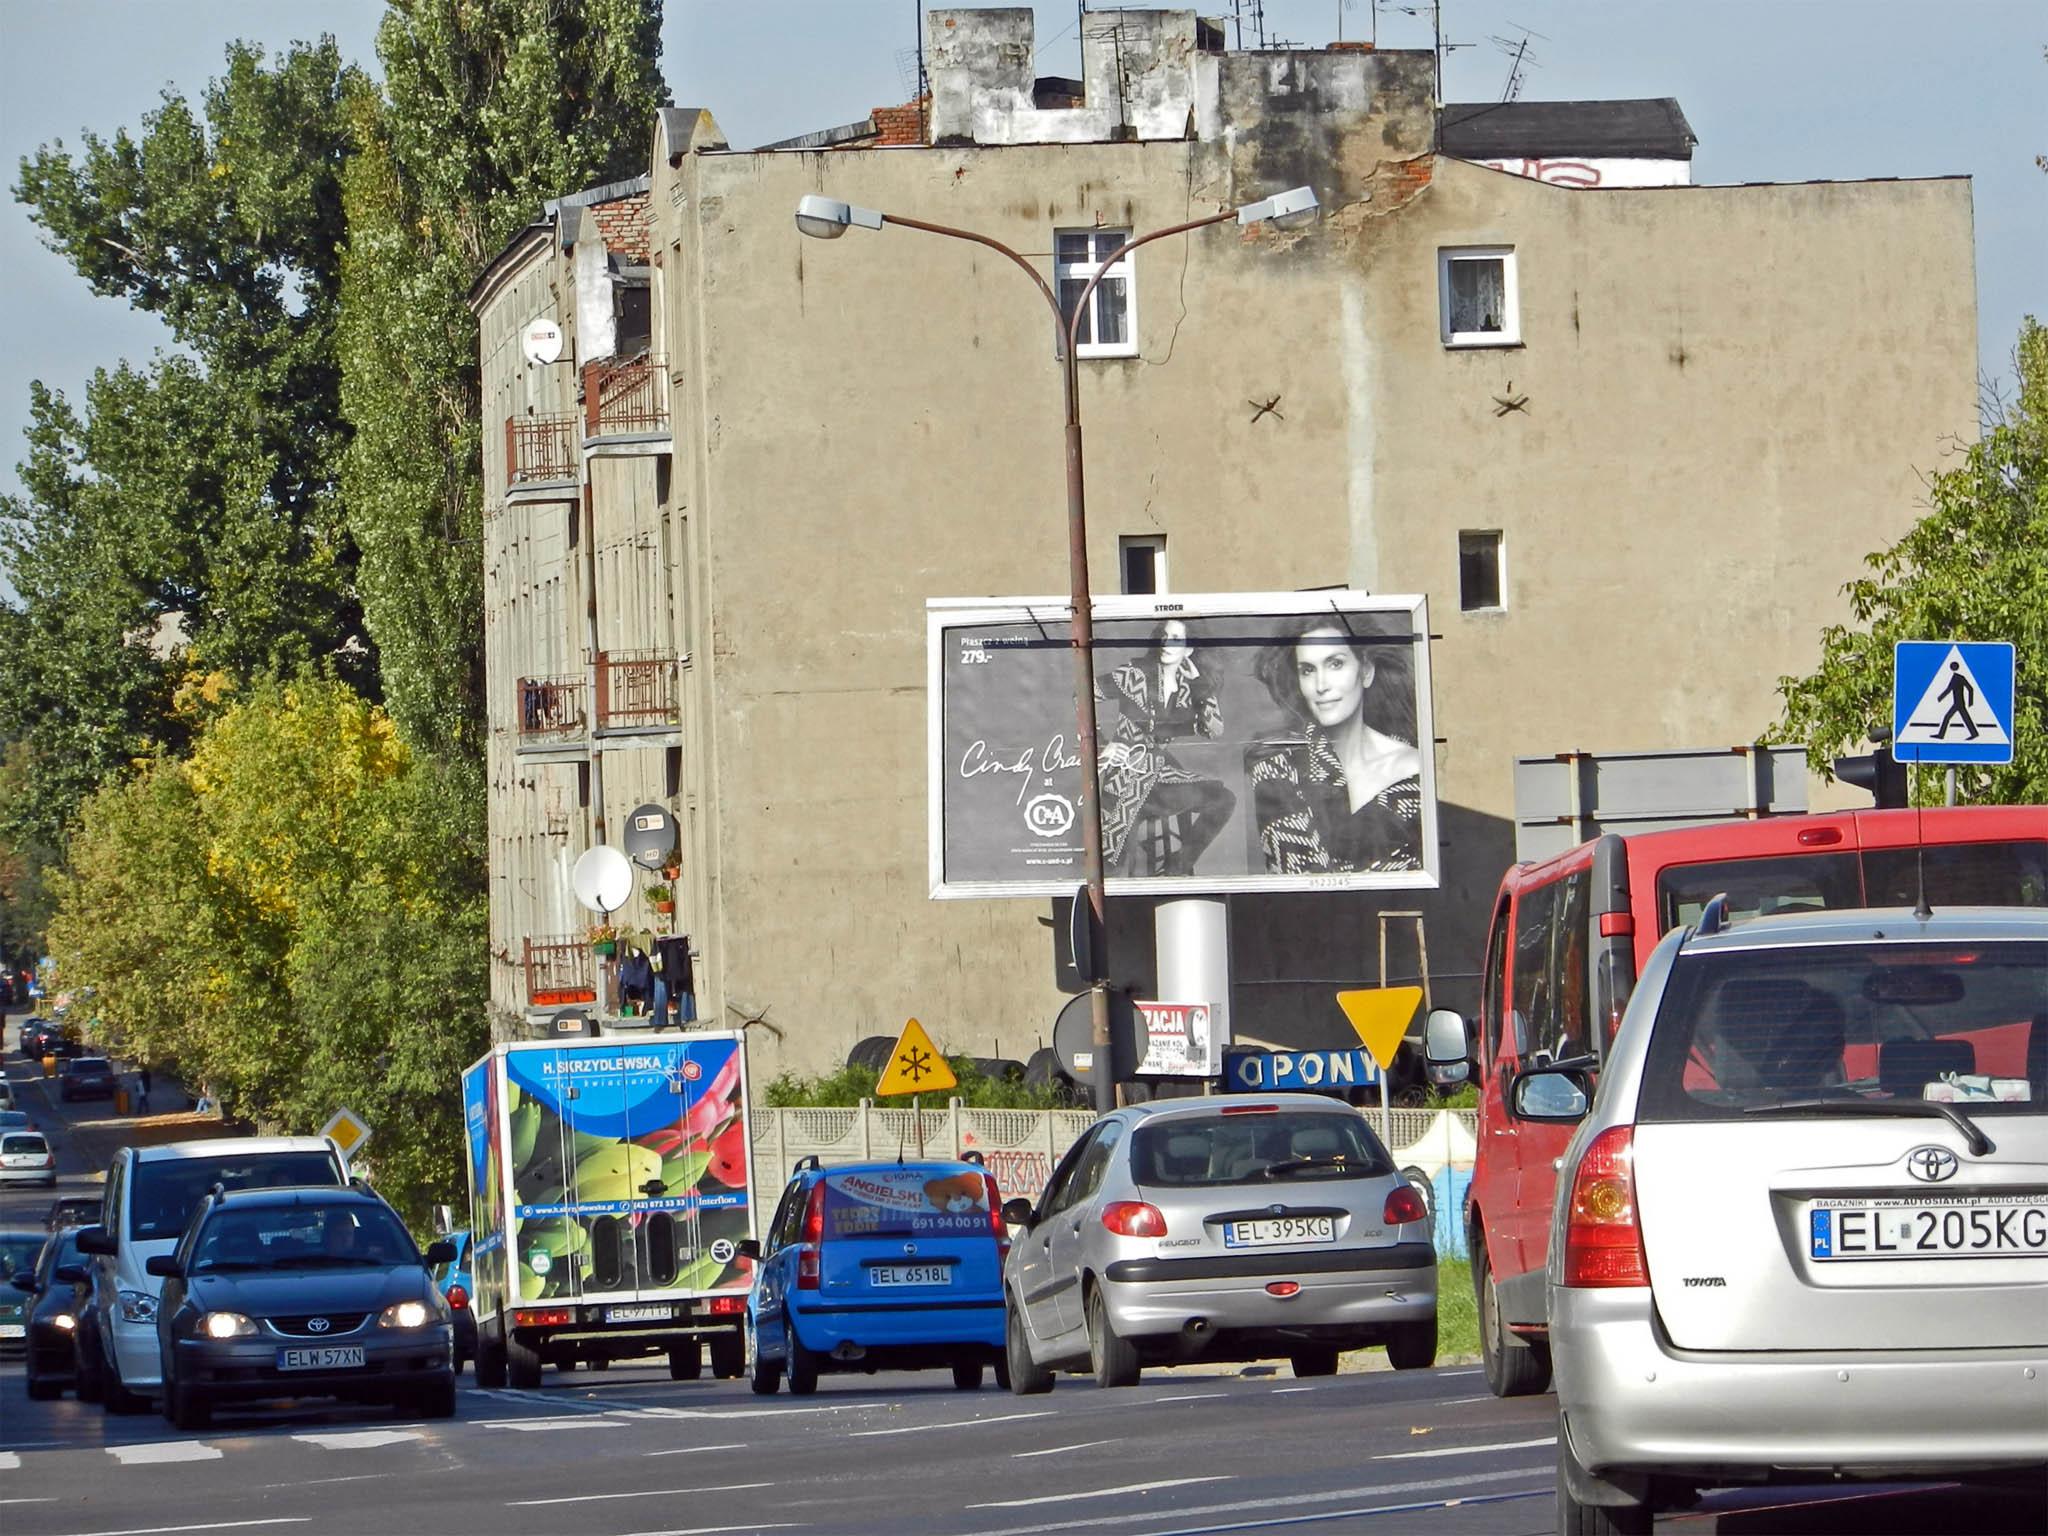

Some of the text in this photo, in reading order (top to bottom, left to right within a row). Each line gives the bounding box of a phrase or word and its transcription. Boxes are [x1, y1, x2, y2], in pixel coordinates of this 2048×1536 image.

[960, 740, 1034, 806] Cindy
[1044, 777, 1054, 787] at
[1032, 805, 1066, 825] C&A
[543, 1056, 662, 1075] H. SKRZYDLEWSKA
[1238, 1051, 1377, 1086] OPONY
[844, 1176, 922, 1203] ANGIELSKI
[699, 1195, 737, 1206] Interflora
[912, 1217, 987, 1229] 691 94 00 91
[1237, 1223, 1264, 1241] EL
[1271, 1218, 1330, 1239] 395KG
[1839, 1209, 2047, 1251] EL 205KG
[1159, 1239, 1201, 1248] PEUGEOT
[1814, 1238, 1829, 1250] PL
[880, 1268, 900, 1283] EL
[906, 1267, 949, 1282] 6518L
[1682, 1277, 1726, 1287] TOYOTA
[287, 1349, 362, 1367] ELW 57XN
